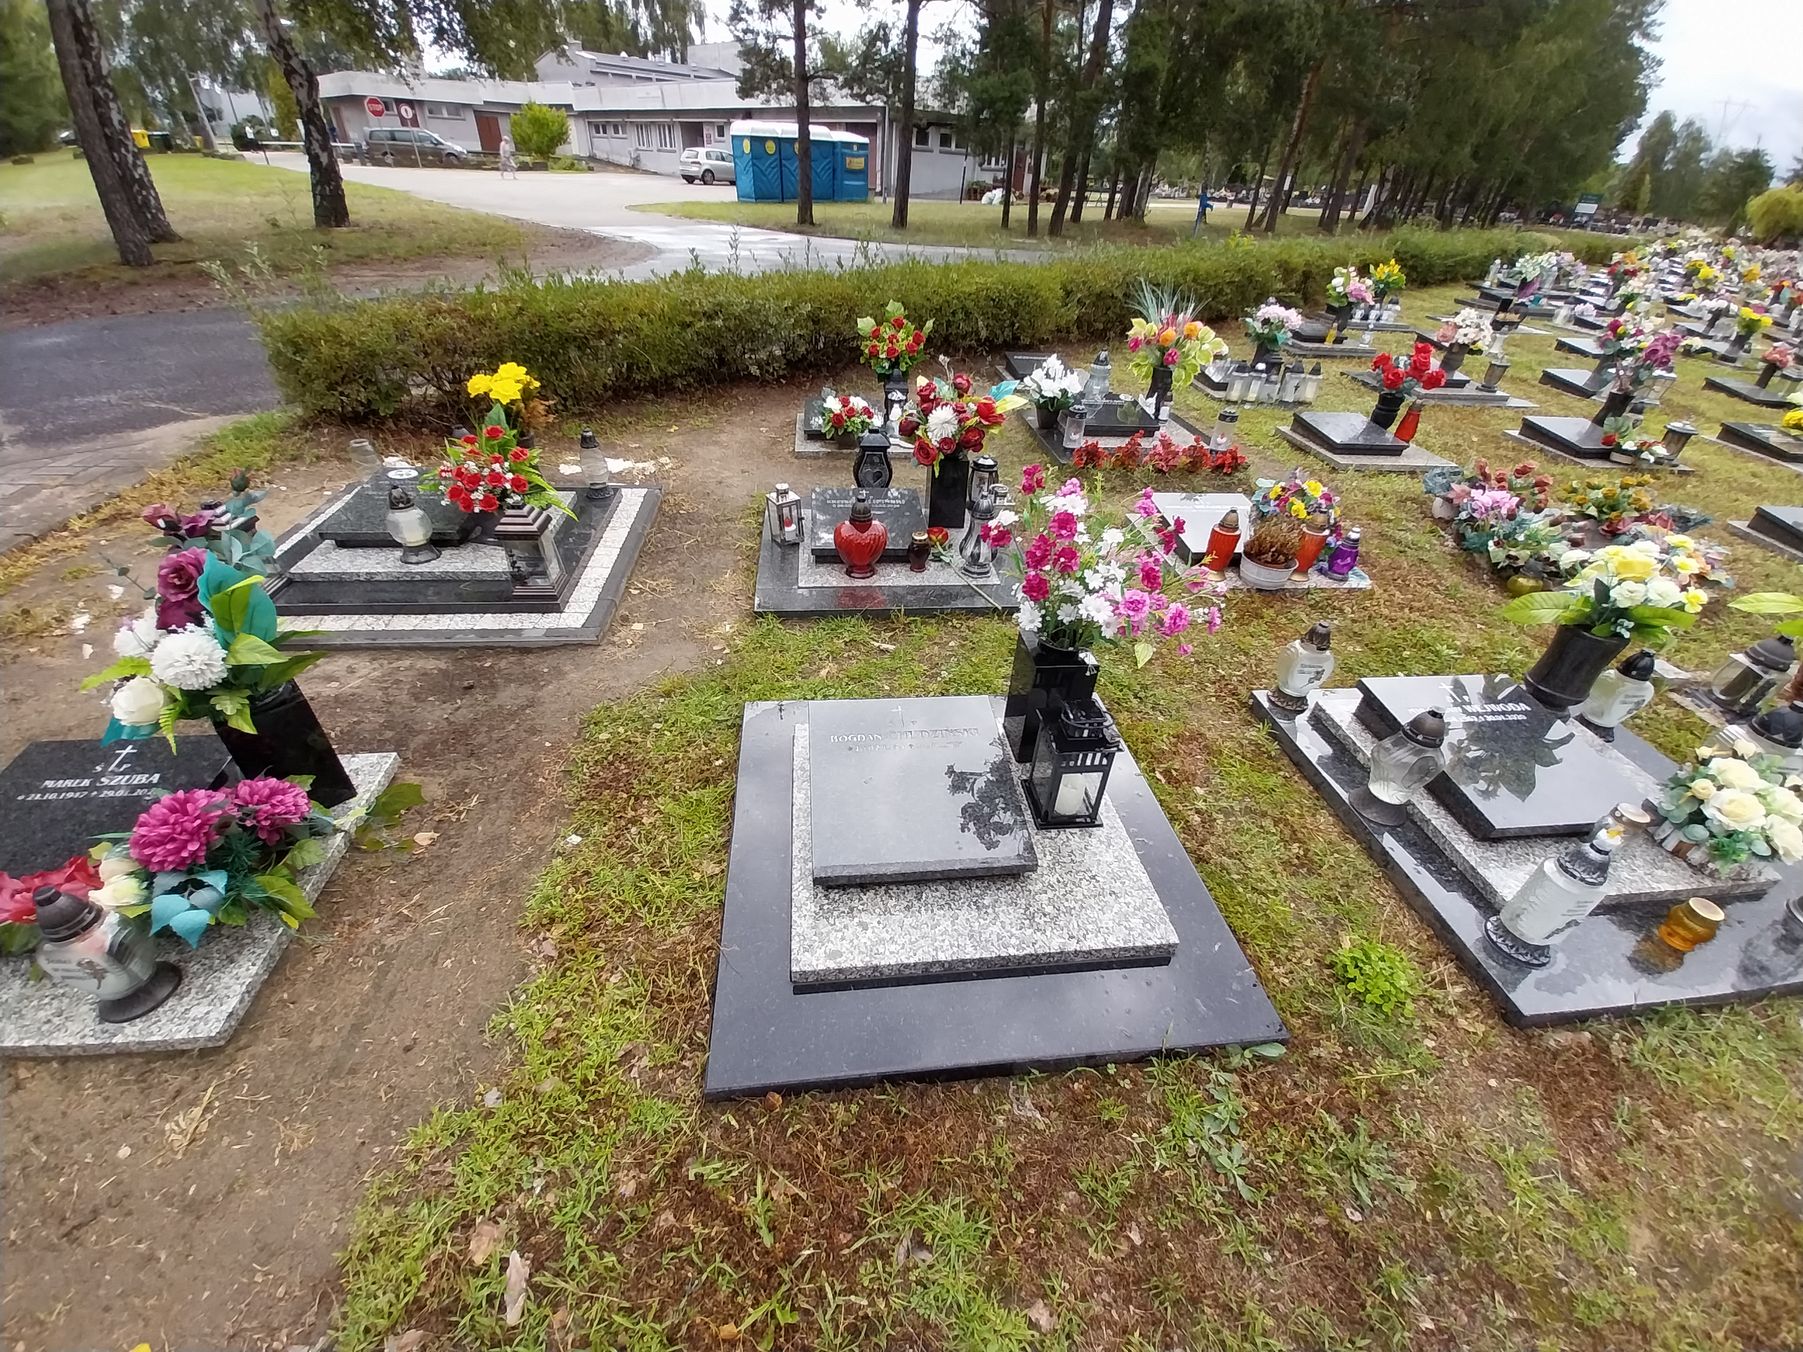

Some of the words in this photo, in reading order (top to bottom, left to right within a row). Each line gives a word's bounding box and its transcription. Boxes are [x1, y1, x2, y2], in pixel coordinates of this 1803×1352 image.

[368, 103, 384, 112] STOP
[830, 733, 883, 744] BOGDAN
[41, 778, 93, 789] MAREK
[96, 773, 160, 786] SZUBA
